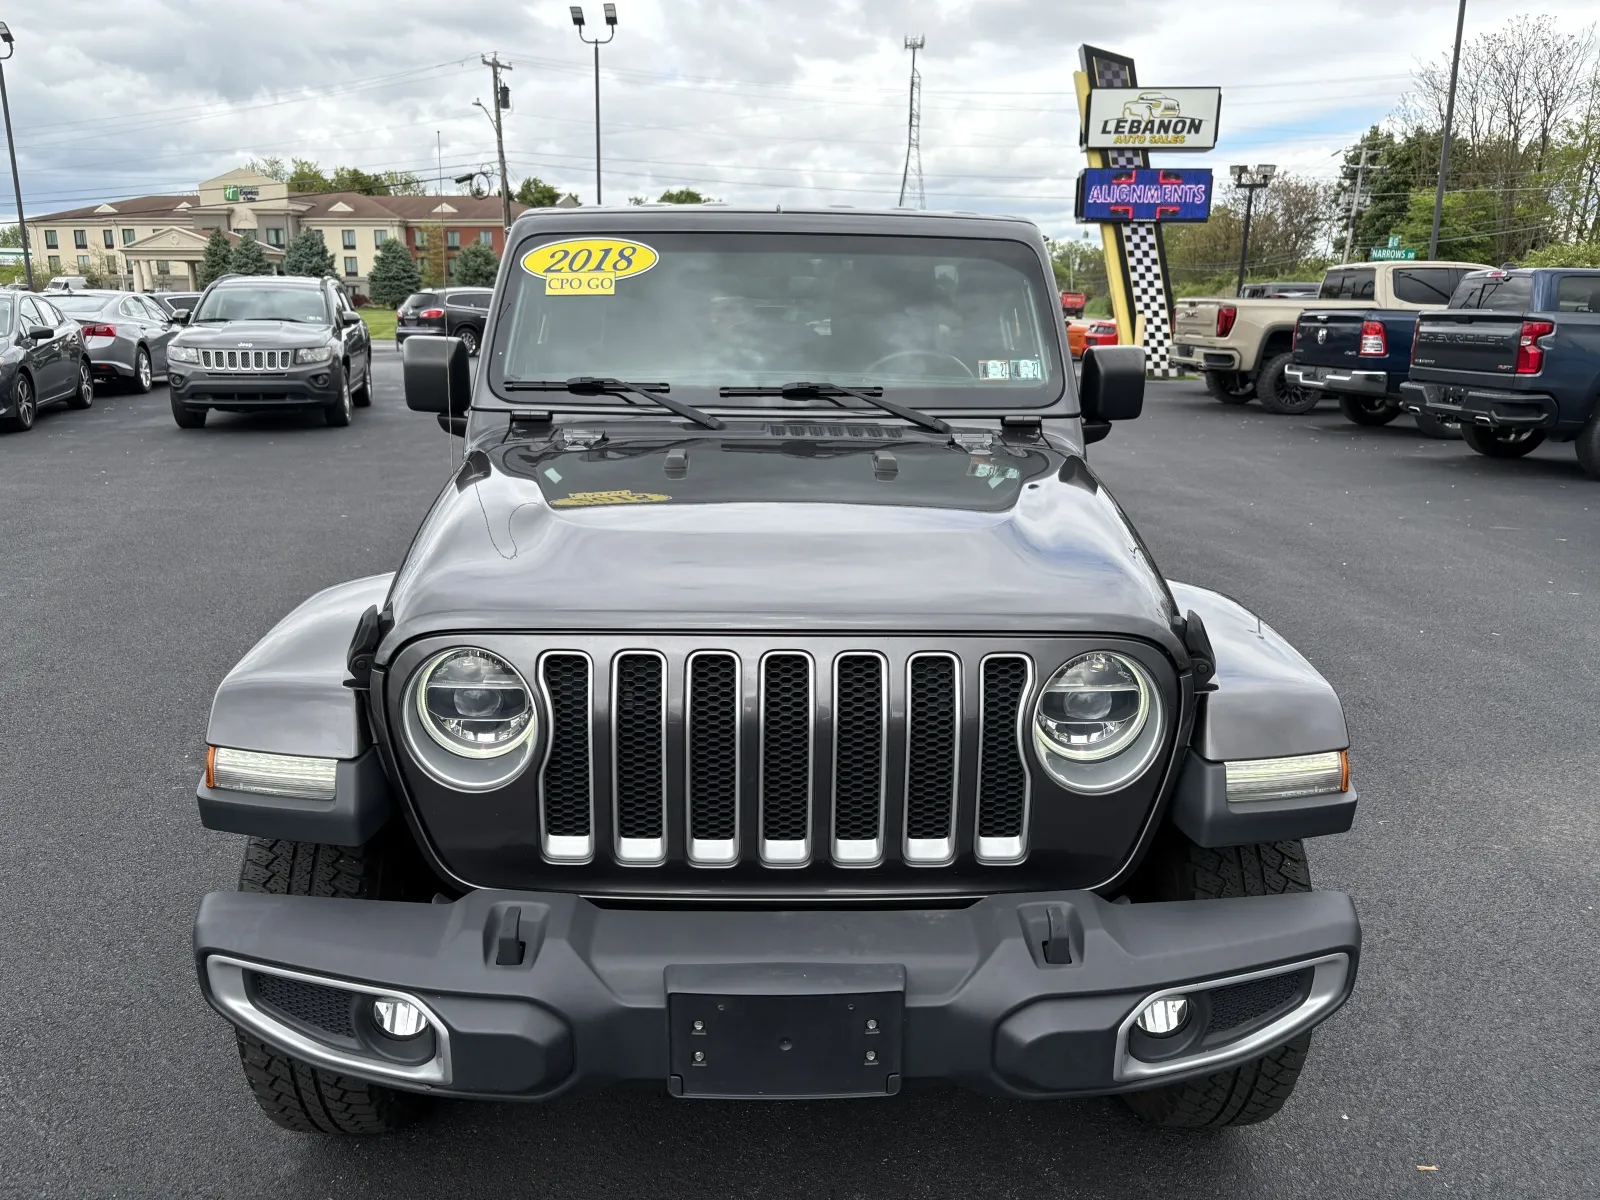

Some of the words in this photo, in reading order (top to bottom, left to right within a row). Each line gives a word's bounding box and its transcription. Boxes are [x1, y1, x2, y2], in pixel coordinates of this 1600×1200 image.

[1101, 119, 1203, 135] LEBANON
[1113, 135, 1146, 144] AUTO
[1148, 135, 1186, 144] SALES
[1088, 184, 1206, 204] ALIGNMENTS
[543, 246, 637, 273] 2018
[1372, 250, 1406, 259] NARROWS
[547, 277, 582, 290] CPO
[587, 277, 613, 290] GO
